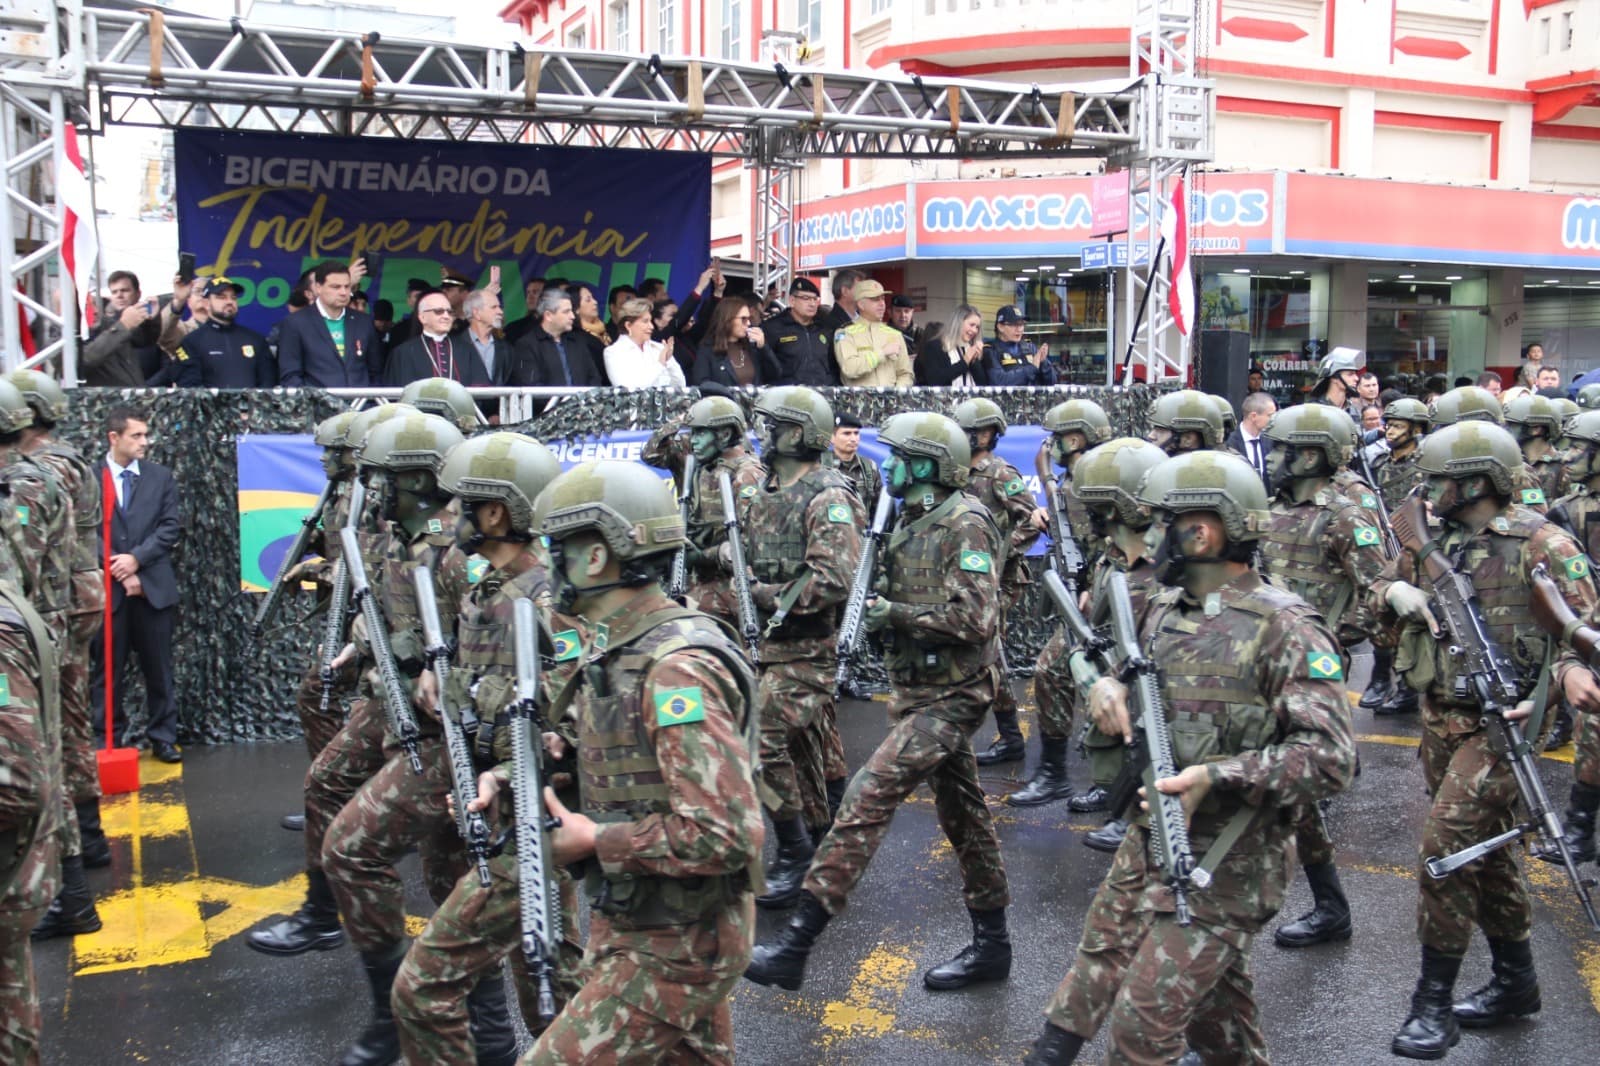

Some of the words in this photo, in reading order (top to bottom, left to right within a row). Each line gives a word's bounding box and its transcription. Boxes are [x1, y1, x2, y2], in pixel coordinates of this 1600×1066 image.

[224, 155, 498, 195] BICENTENÁRIO
[503, 167, 551, 196] DA
[194, 184, 648, 277] Independência
[1263, 360, 1309, 371] CORRER
